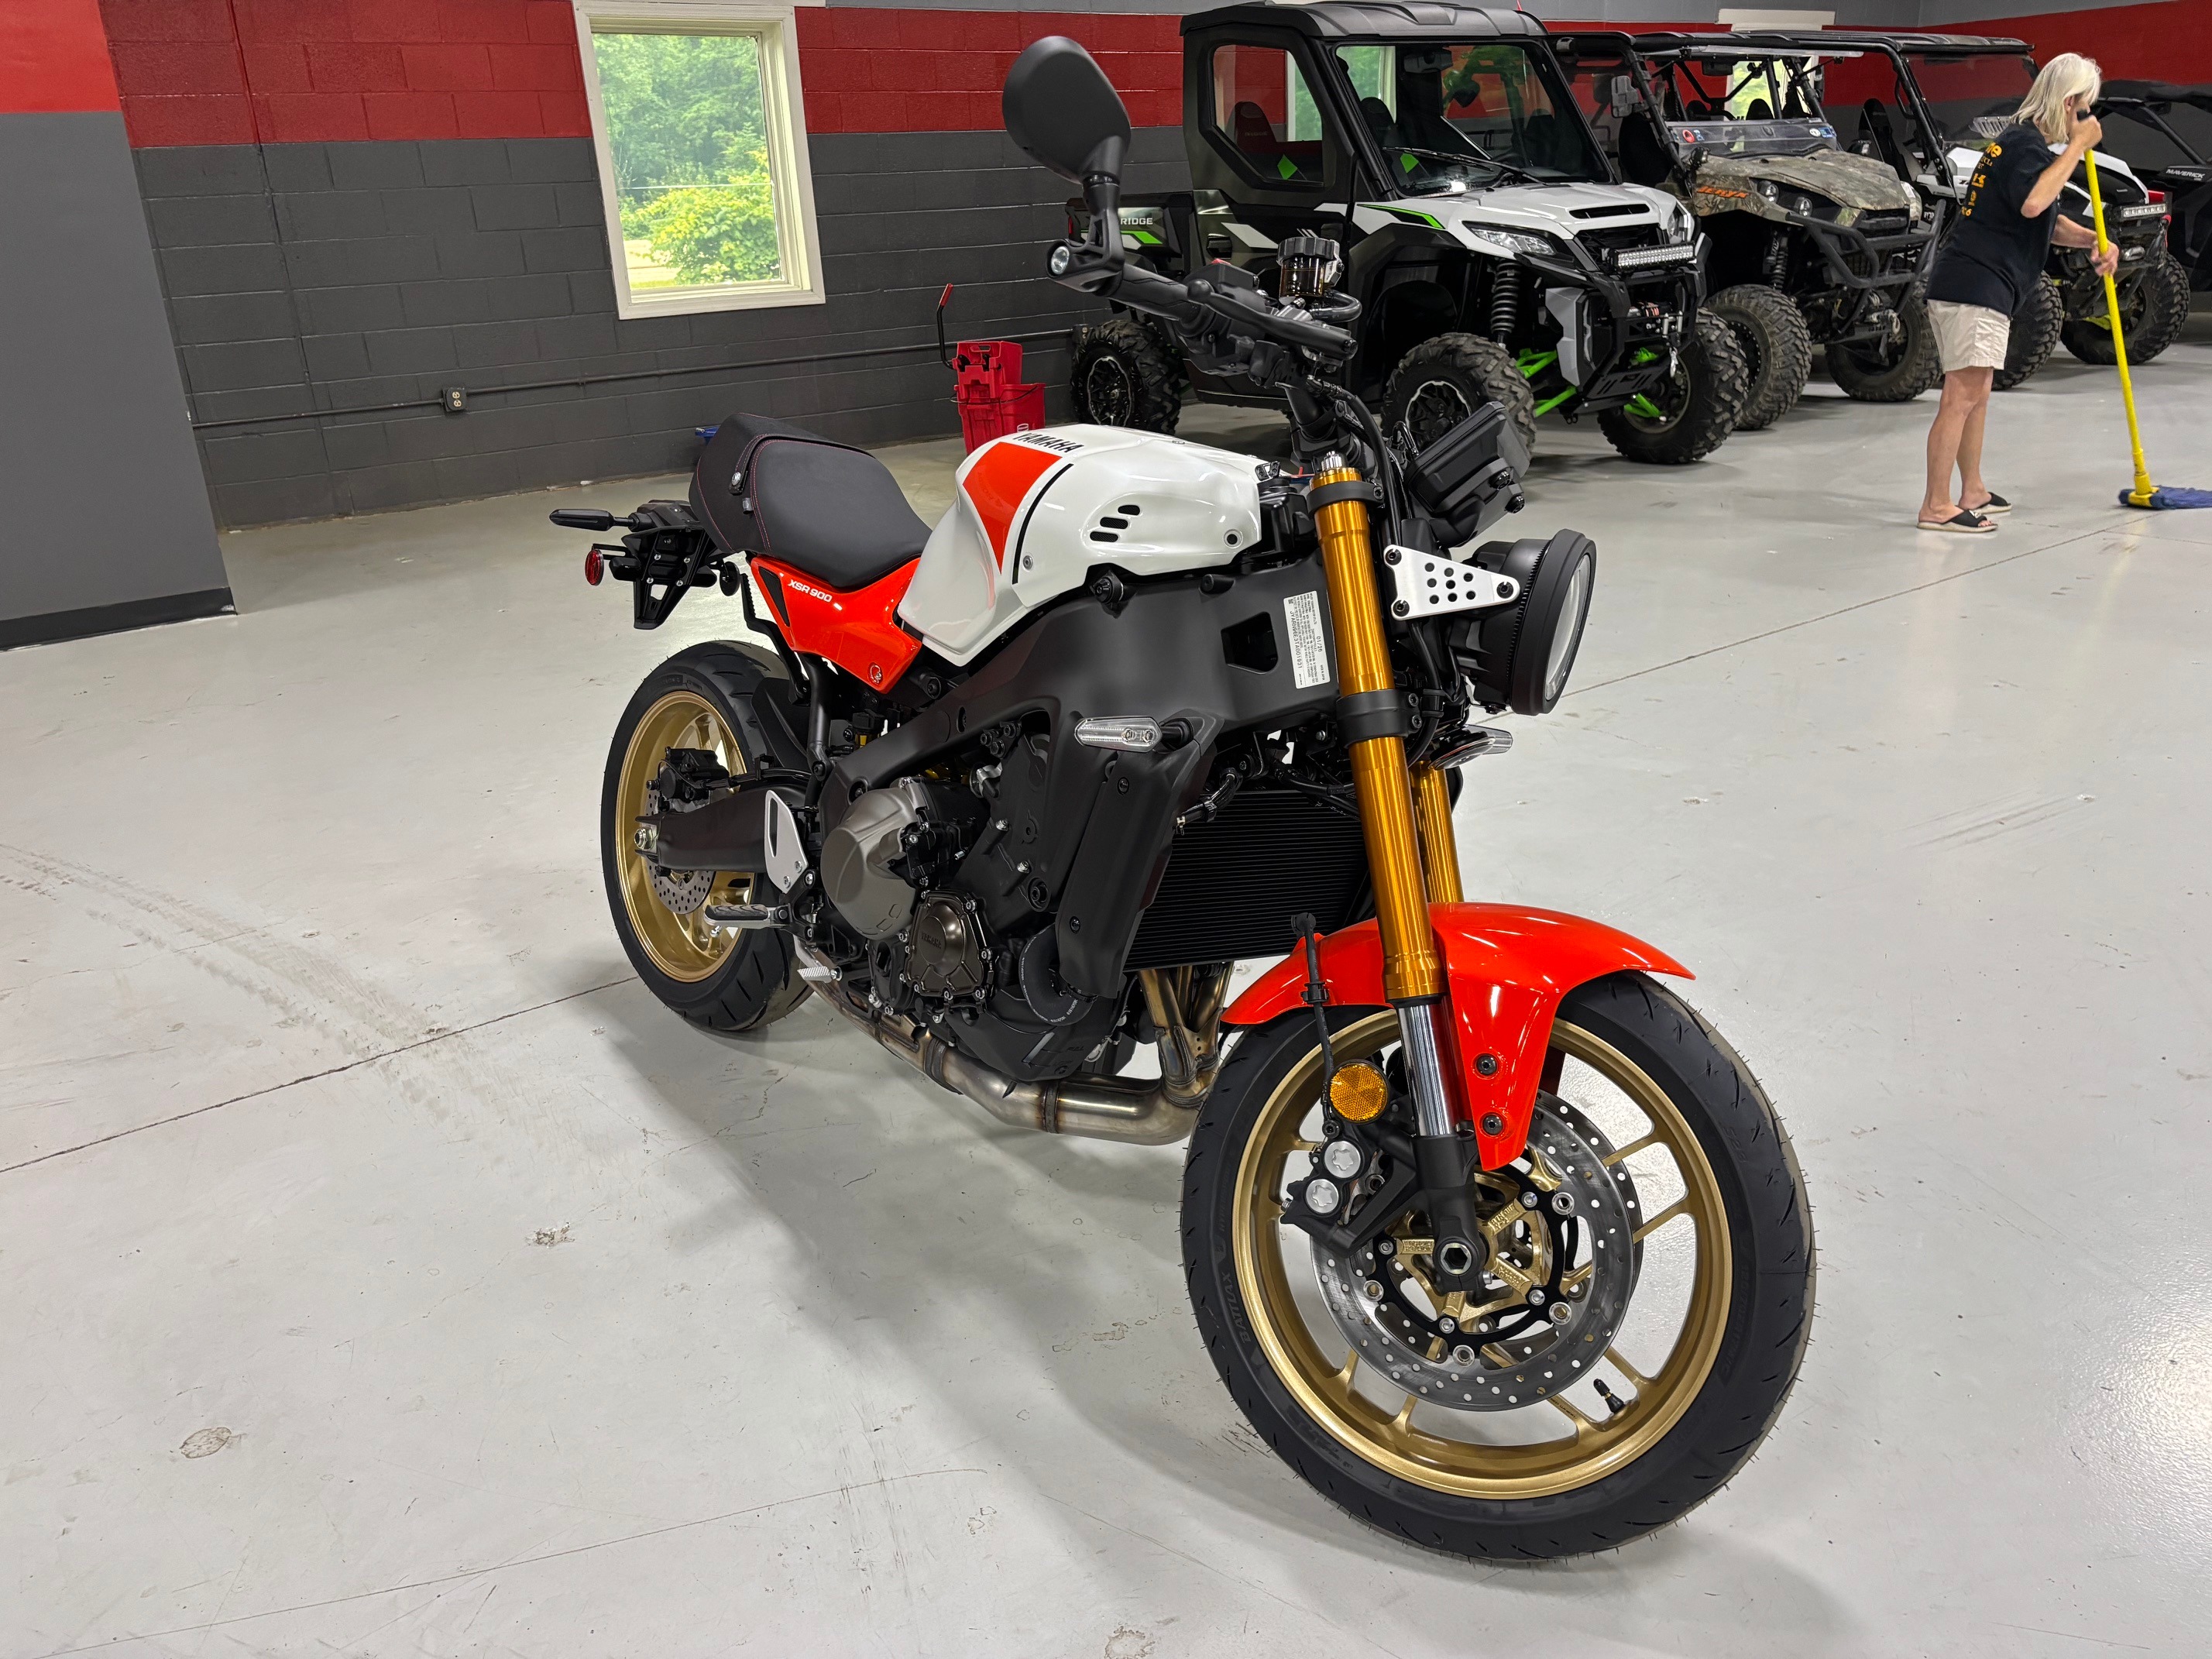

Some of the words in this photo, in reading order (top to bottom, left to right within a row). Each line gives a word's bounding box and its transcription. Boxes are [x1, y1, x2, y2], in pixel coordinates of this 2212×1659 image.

[2166, 169, 2205, 179] MAVERICK
[1012, 433, 1084, 453] YAMAHA
[788, 579, 811, 594] XSR
[809, 589, 833, 603] 900
[1221, 1271, 1252, 1343] BATTLAX
